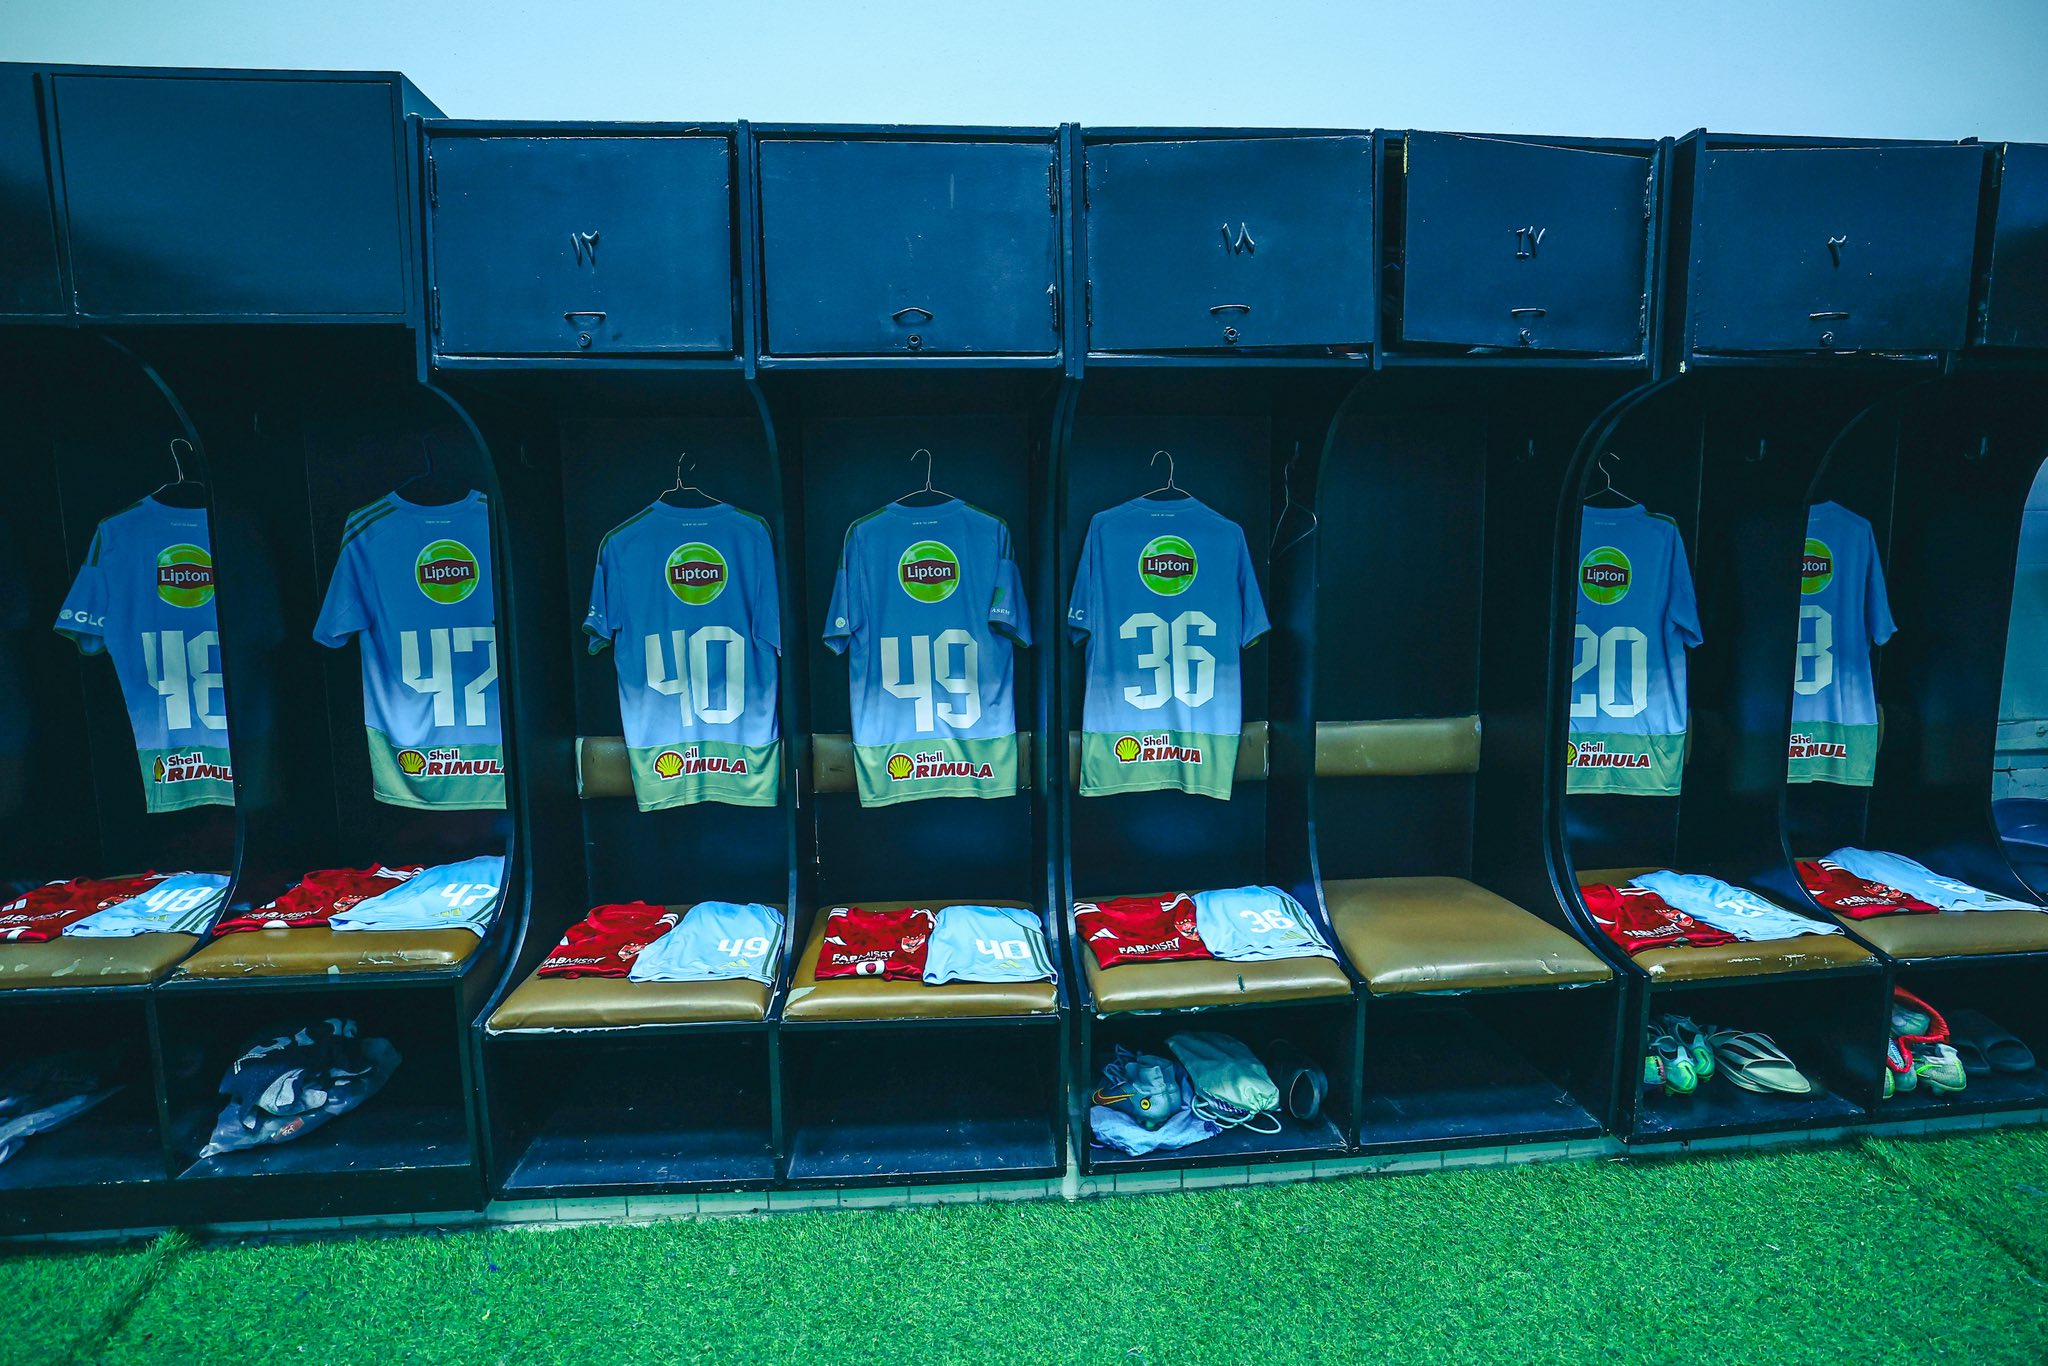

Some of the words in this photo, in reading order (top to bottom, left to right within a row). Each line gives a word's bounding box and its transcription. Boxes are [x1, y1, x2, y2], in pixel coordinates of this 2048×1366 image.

[425, 564, 470, 581] Lipton
[675, 566, 718, 582] Lipton
[908, 564, 951, 580] Lipton
[1147, 558, 1190, 574] Lipton
[161, 568, 210, 585] Lipton
[1586, 568, 1625, 584] Lipton
[1120, 611, 1217, 710] 36
[400, 626, 499, 727] 47
[645, 626, 745, 728] 40
[880, 629, 982, 733] 49
[1144, 735, 1168, 746] Shell
[1580, 742, 1603, 753] Shell
[168, 753, 202, 767] Shell
[429, 749, 459, 760] Shell
[916, 751, 943, 763] Shell
[1577, 753, 1650, 768] RIMULA
[427, 760, 505, 775] RIMUL
[915, 762, 993, 779] RIMULA
[145, 886, 214, 914] 48
[1240, 909, 1296, 934] 36
[717, 936, 770, 959] 49
[975, 939, 1031, 960] 40
